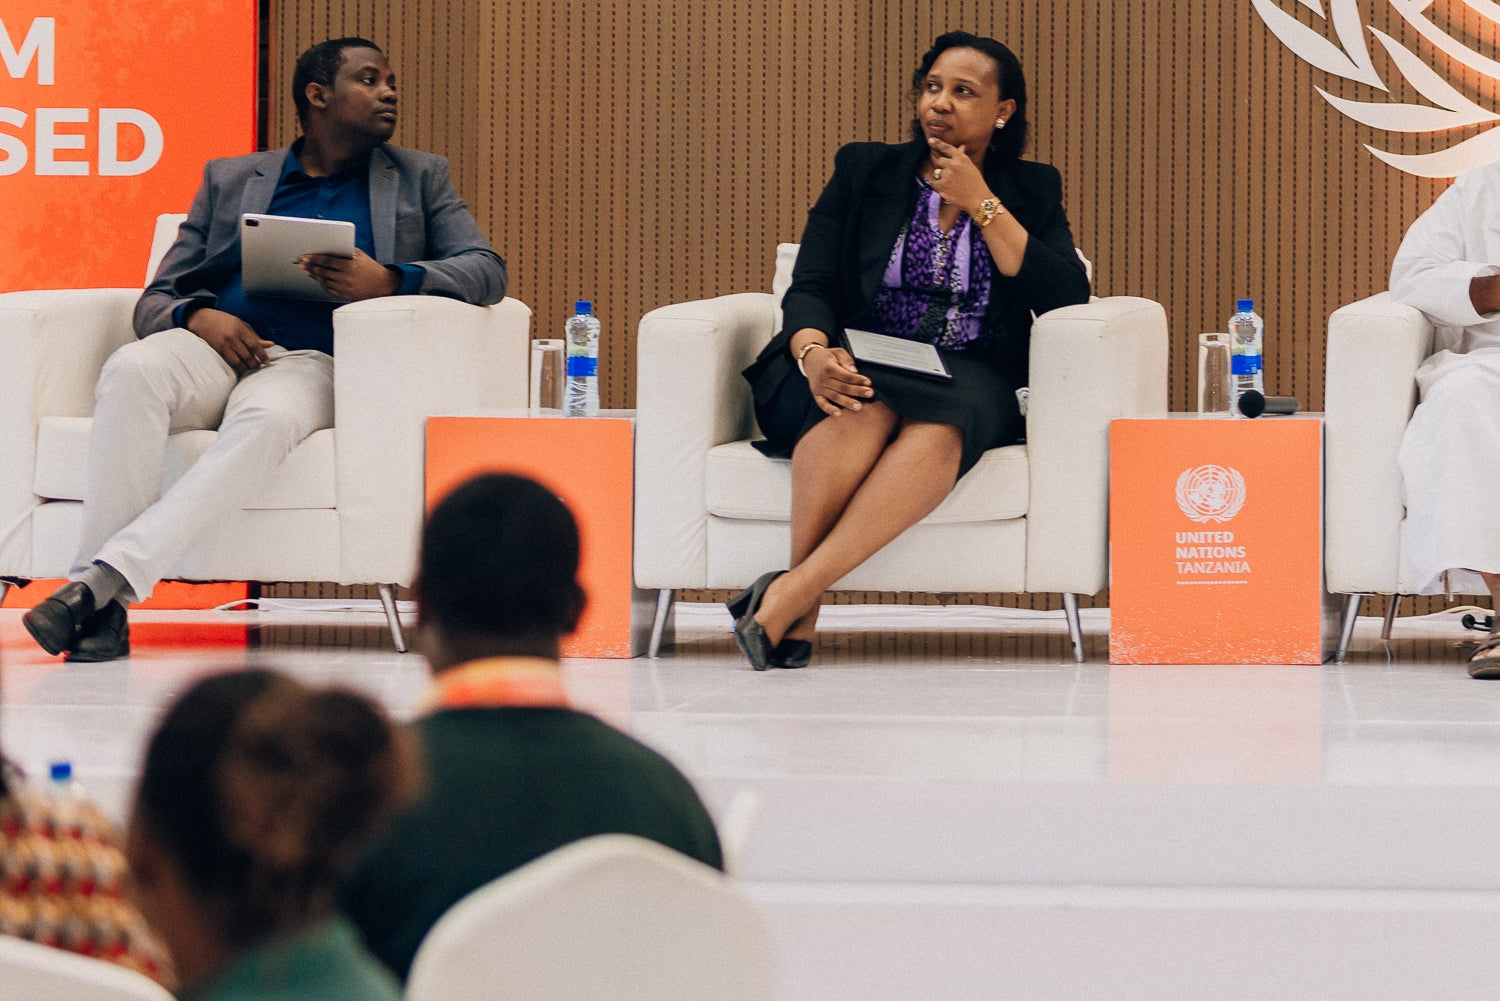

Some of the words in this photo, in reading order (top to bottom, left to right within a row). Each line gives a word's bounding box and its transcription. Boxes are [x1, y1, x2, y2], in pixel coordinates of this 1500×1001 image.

[1175, 532, 1234, 544] UNITED
[1175, 546, 1246, 559] NATIONS
[1175, 561, 1252, 574] TANZANIA
